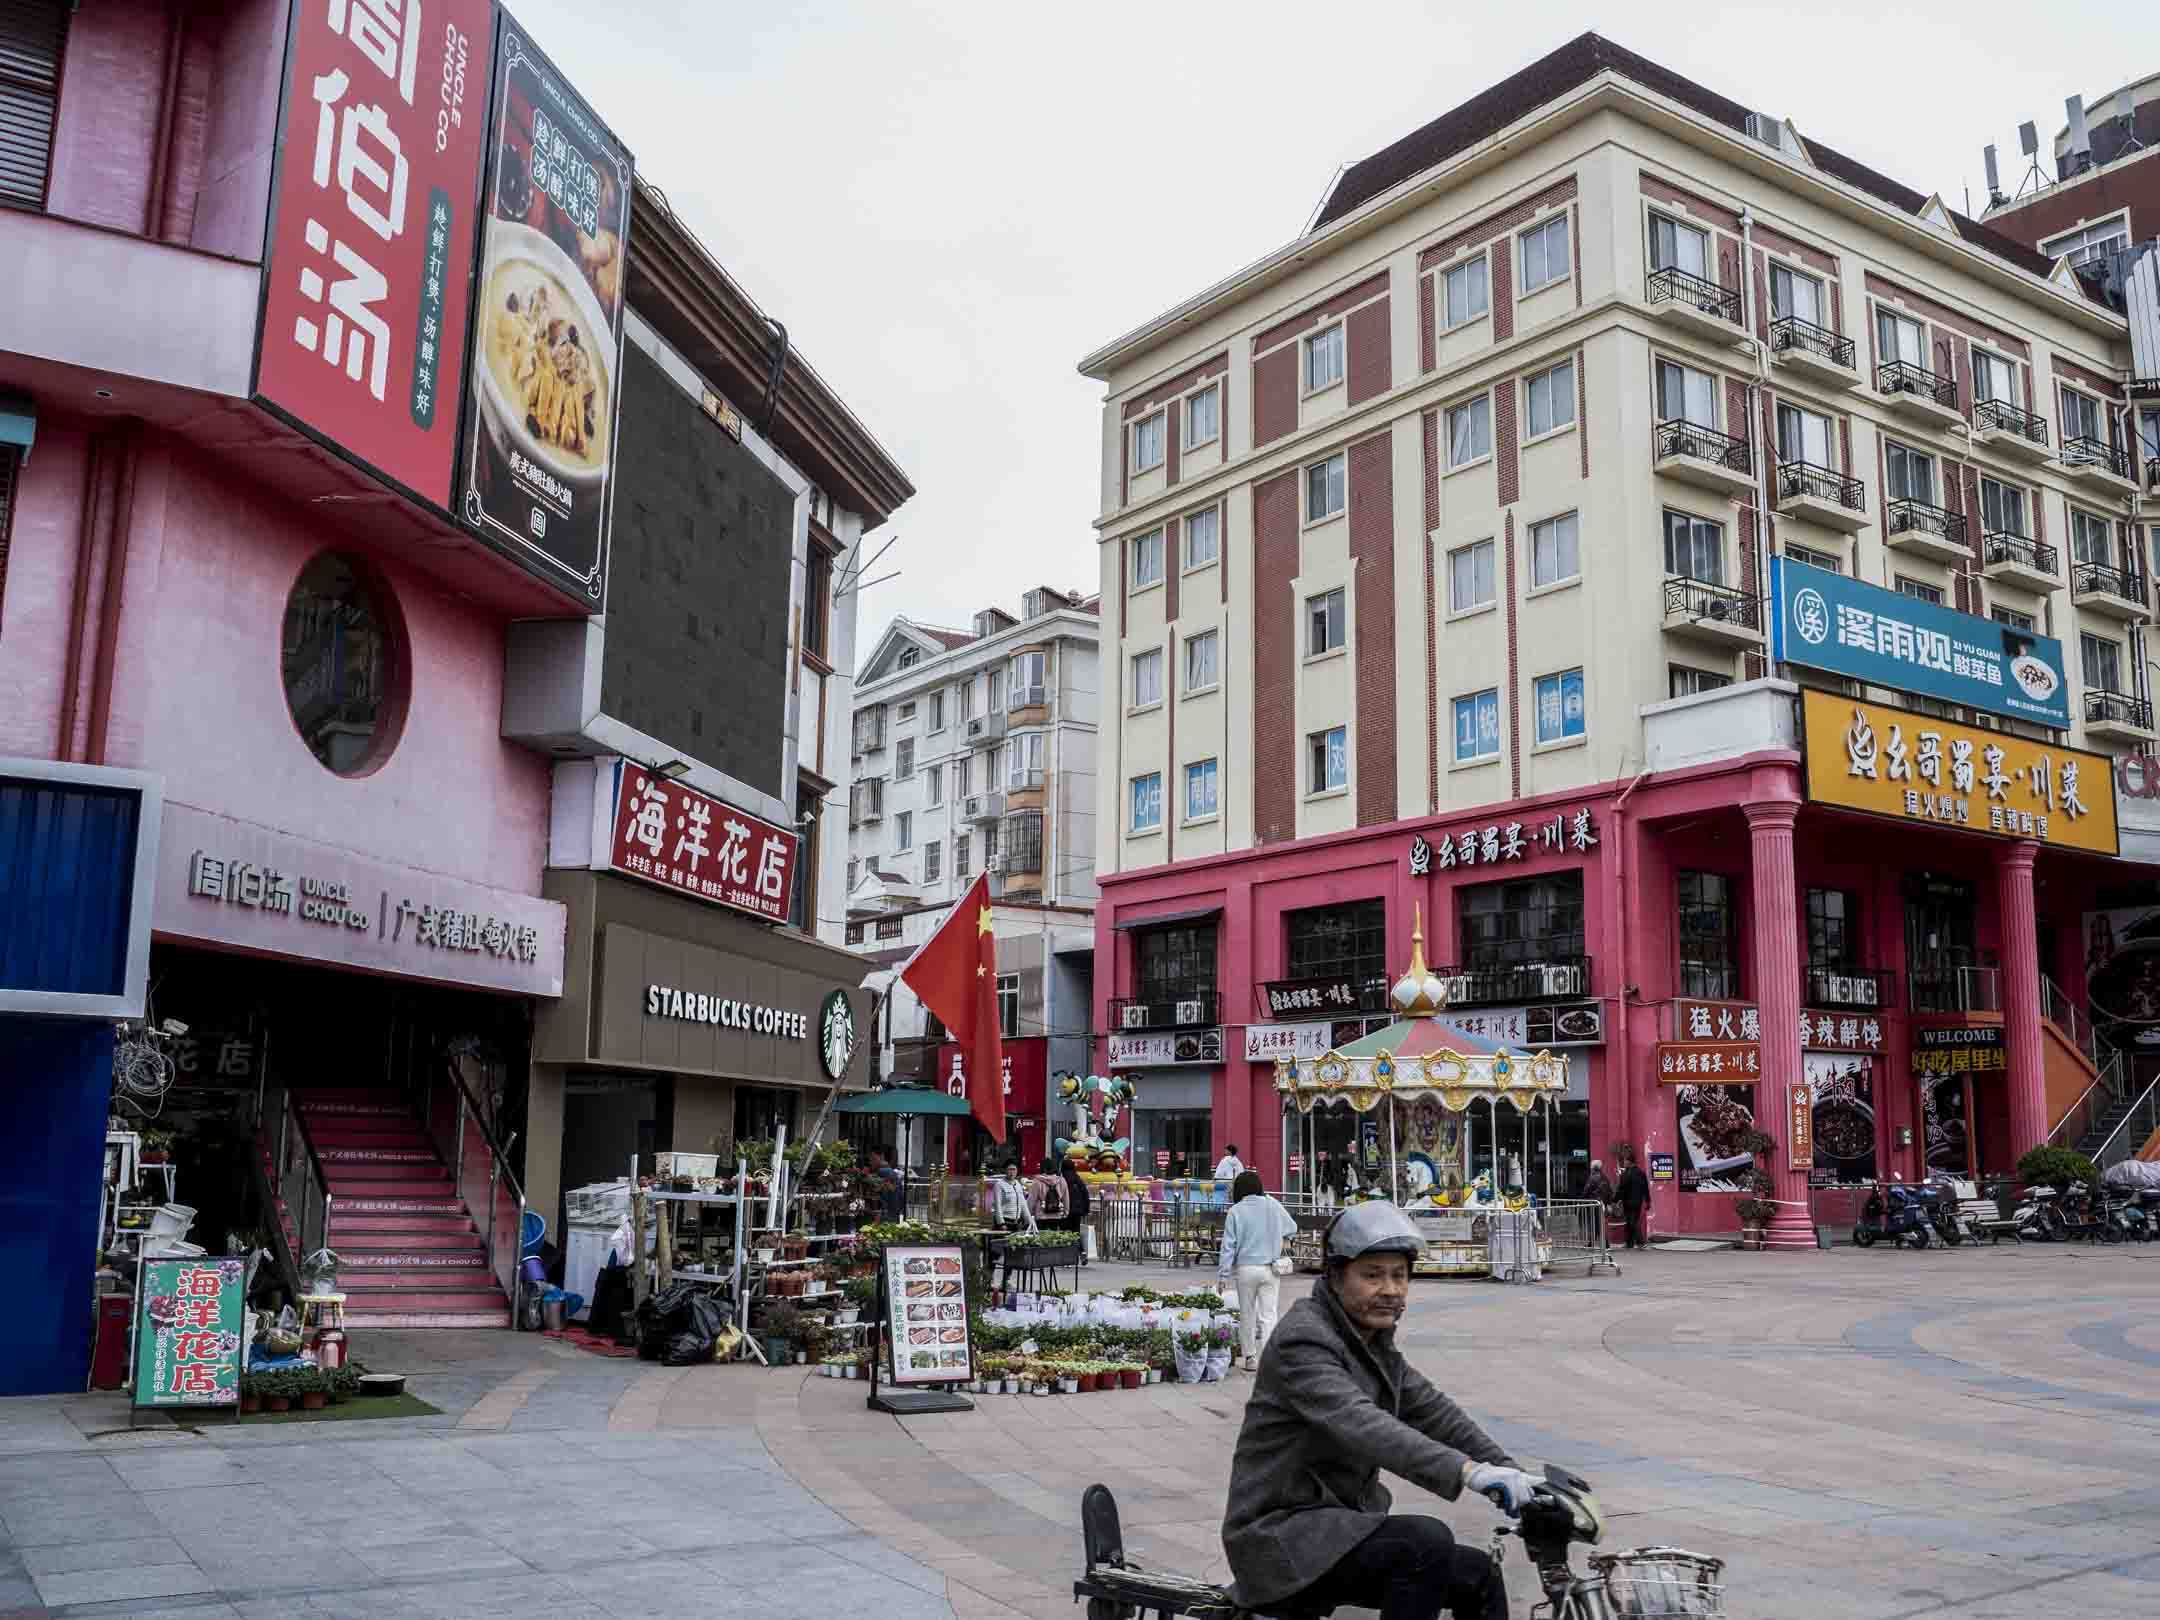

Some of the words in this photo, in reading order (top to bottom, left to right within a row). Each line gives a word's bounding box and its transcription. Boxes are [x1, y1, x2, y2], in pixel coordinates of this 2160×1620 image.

[443, 23, 457, 106] CHOU
[451, 33, 469, 129] UNCLE
[435, 108, 449, 153] CO.
[1837, 604, 1952, 673] 溪雨观
[1963, 643, 1975, 654] YU
[1976, 648, 2001, 661] GUAN
[1953, 654, 2003, 686] 酸菜鱼
[625, 776, 788, 899] 海洋花店
[302, 868, 353, 902] UNCLE
[302, 899, 346, 925] CHOU
[648, 984, 751, 1032] STARBUCKS
[753, 1005, 808, 1040] COFFEE
[1923, 1029, 1996, 1043] WELCOME
[171, 1268, 223, 1394] 海洋花店
